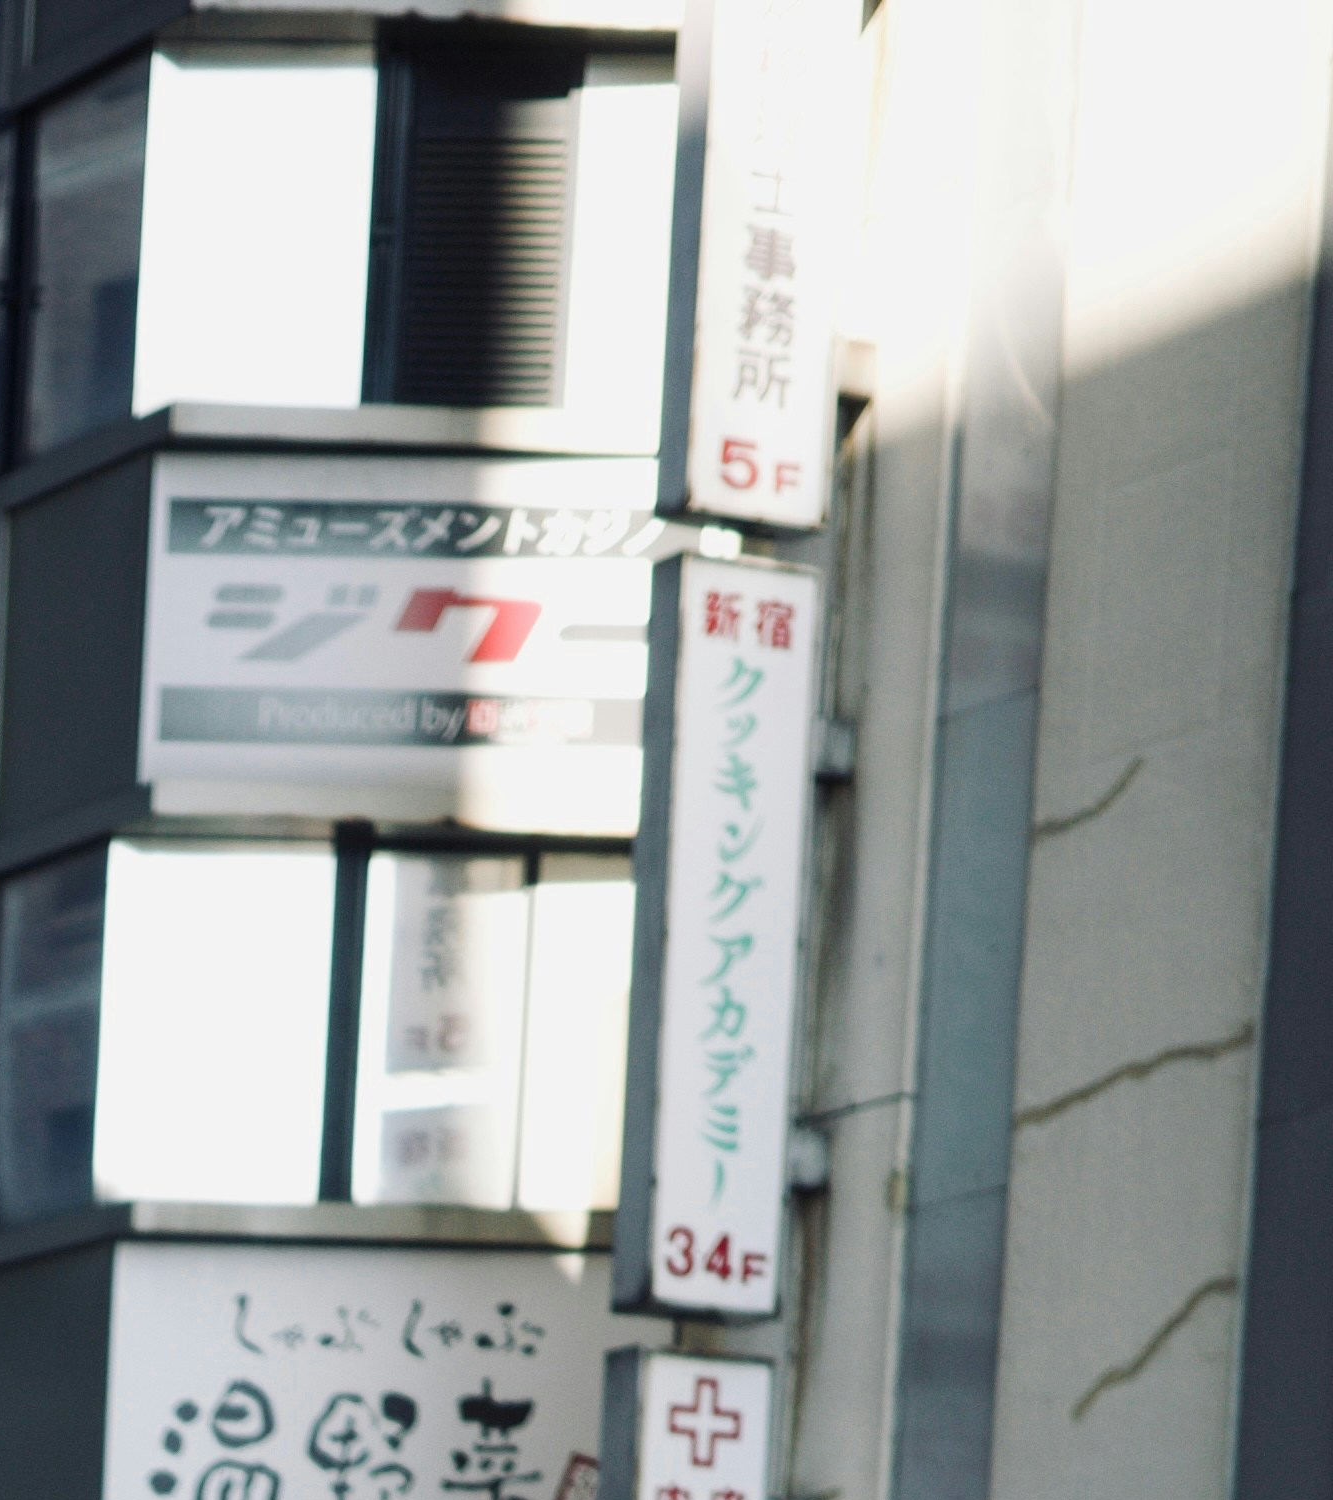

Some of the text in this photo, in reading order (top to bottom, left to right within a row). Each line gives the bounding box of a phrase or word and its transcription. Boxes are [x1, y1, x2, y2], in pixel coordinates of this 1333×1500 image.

[719, 436, 804, 494] 5F
[702, 588, 796, 651] 新宿
[697, 656, 768, 1207] クッキングアカデミー
[233, 1293, 547, 1357] しゃぶしゃぶ
